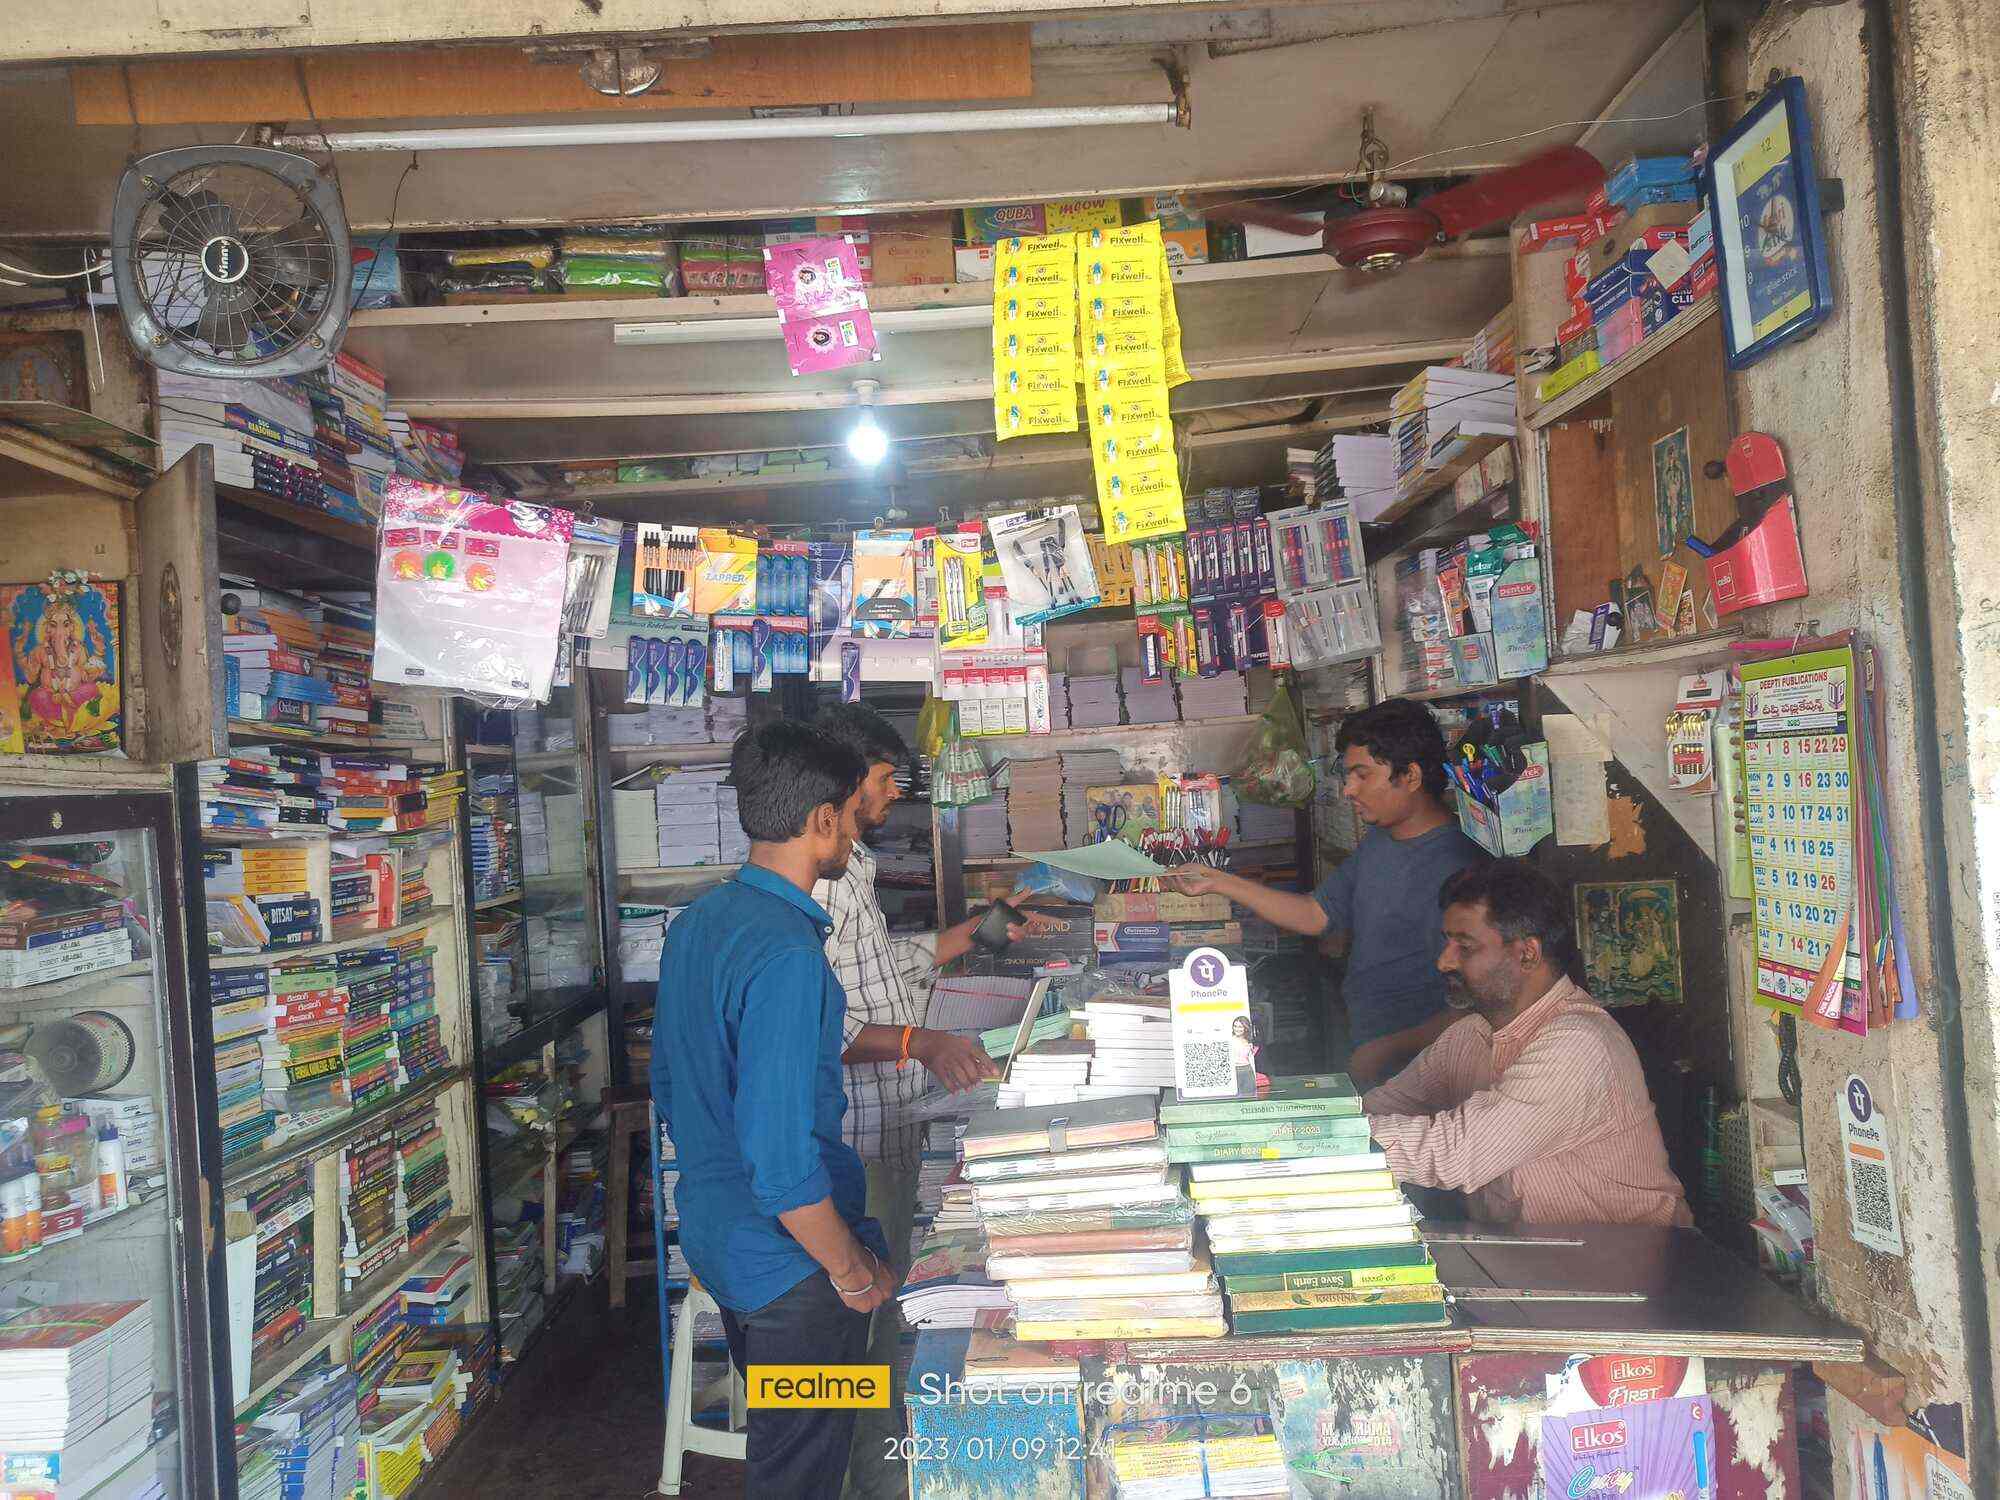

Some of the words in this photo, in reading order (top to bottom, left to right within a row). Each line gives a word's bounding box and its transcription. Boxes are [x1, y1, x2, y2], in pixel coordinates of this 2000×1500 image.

[995, 206, 1034, 222] QUBA
[1782, 671, 1828, 687] PUBLICATIONS
[1766, 742, 1772, 755] 1
[1783, 741, 1790, 754] 8
[1799, 739, 1811, 753] 15
[1814, 739, 1828, 753] 22
[1832, 737, 1846, 752] 29
[1767, 773, 1774, 787] 2
[1784, 773, 1791, 787] 9
[1800, 772, 1812, 787] 16
[1817, 773, 1831, 788] 23
[1835, 772, 1849, 787] 30
[1768, 805, 1775, 819] 3
[1783, 805, 1795, 820] 10
[1800, 805, 1813, 820] 17
[1818, 805, 1832, 821] 24
[1837, 806, 1849, 821] 31
[1770, 837, 1777, 851] 4
[1784, 839, 1795, 853] 11
[1802, 839, 1815, 854] 18
[1819, 841, 1834, 857] 25
[1772, 870, 1778, 884] 5
[1786, 872, 1798, 887] 12
[1803, 873, 1817, 889] 19
[1821, 875, 1835, 891] 26
[1775, 901, 1781, 915] 6
[1788, 903, 1801, 919] 13
[1805, 906, 1819, 922] 20
[1823, 908, 1837, 925] 27
[1778, 933, 1783, 947] 7
[1791, 936, 1804, 952] 14
[1807, 940, 1820, 957] 21
[1190, 990, 1228, 998] PhonePe
[1848, 1122, 1880, 1142] PhonePe
[1293, 1275, 1318, 1287] Earth
[1320, 1274, 1345, 1286] Save
[1613, 1360, 1653, 1379] Elkos
[1574, 1428, 1624, 1449] Elkos
